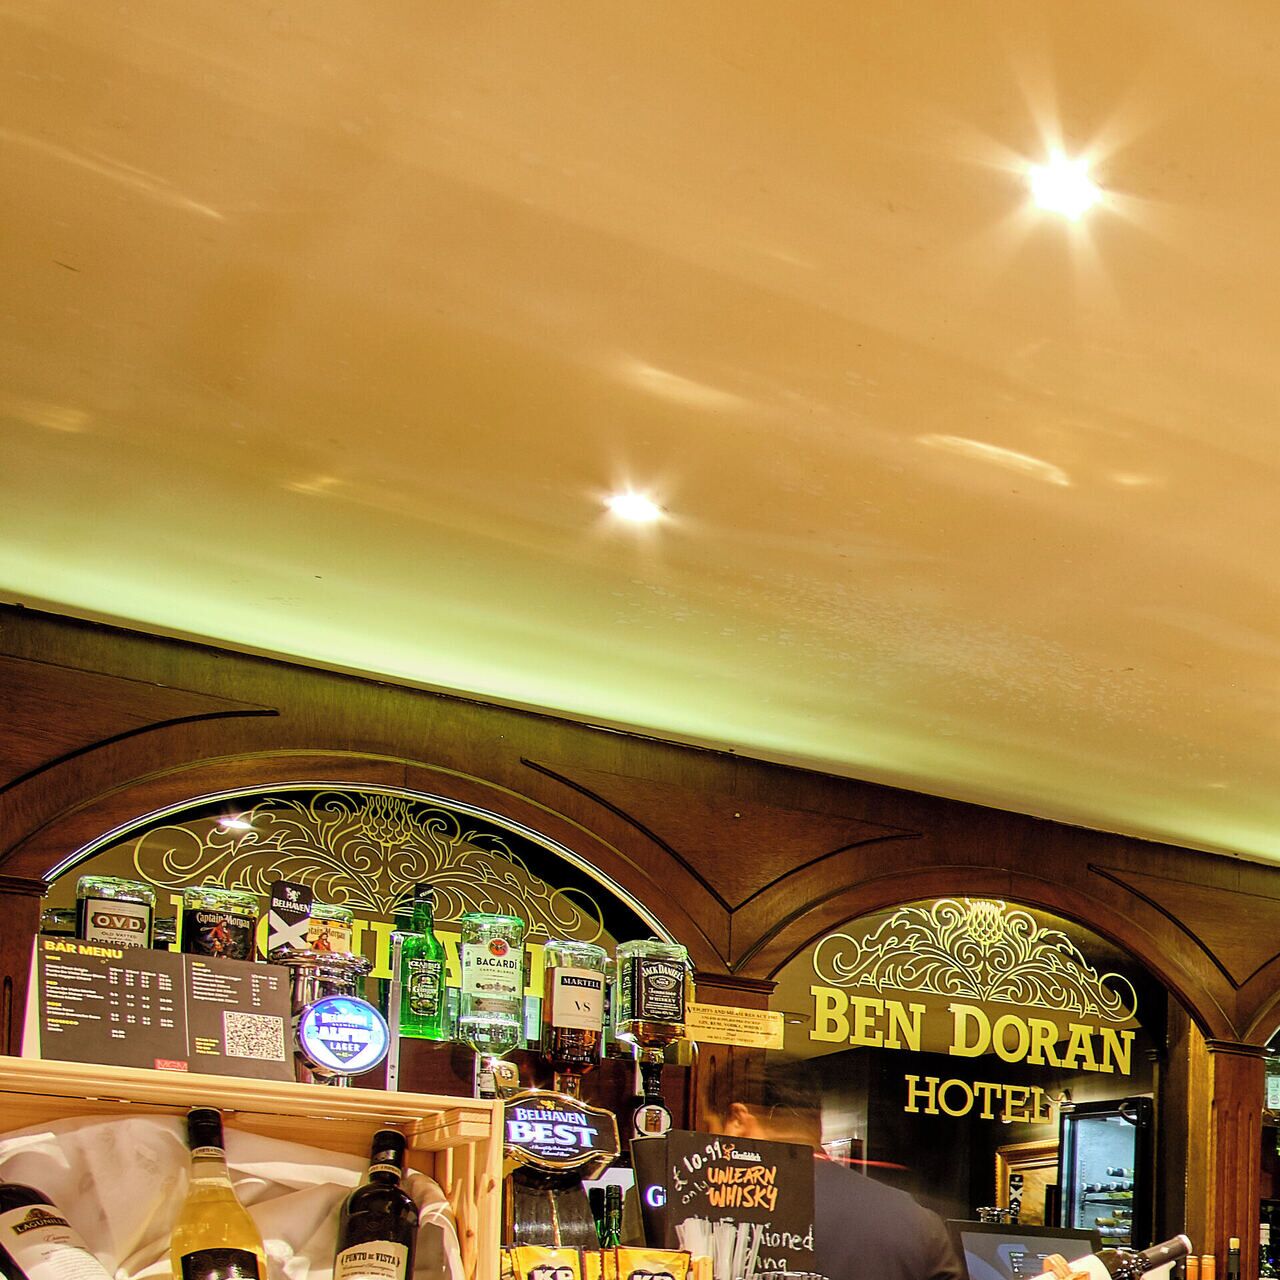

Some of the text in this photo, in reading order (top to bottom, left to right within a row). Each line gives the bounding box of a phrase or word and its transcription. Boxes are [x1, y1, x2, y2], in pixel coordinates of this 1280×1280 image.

[272, 898, 309, 913] BELHAVEN
[96, 914, 142, 932] O.V.D.
[196, 912, 250, 929] Captain Morgan
[44, 940, 123, 959] BAR MENU
[562, 977, 600, 989] MARTELL
[642, 965, 660, 978] JACK
[659, 965, 684, 982] DANIEL'S
[574, 1001, 591, 1012] VS
[809, 985, 1136, 1076] BEN DORAN
[904, 1074, 1053, 1124] HOTEL
[515, 1107, 588, 1126] BELHAVEN
[507, 1119, 599, 1148] BEST
[707, 1165, 777, 1186] UNLEARN
[682, 1180, 710, 1205] only
[708, 1185, 778, 1212] WHISKY
[345, 1252, 367, 1263] PUNTO
[375, 1252, 396, 1265] VISTA
